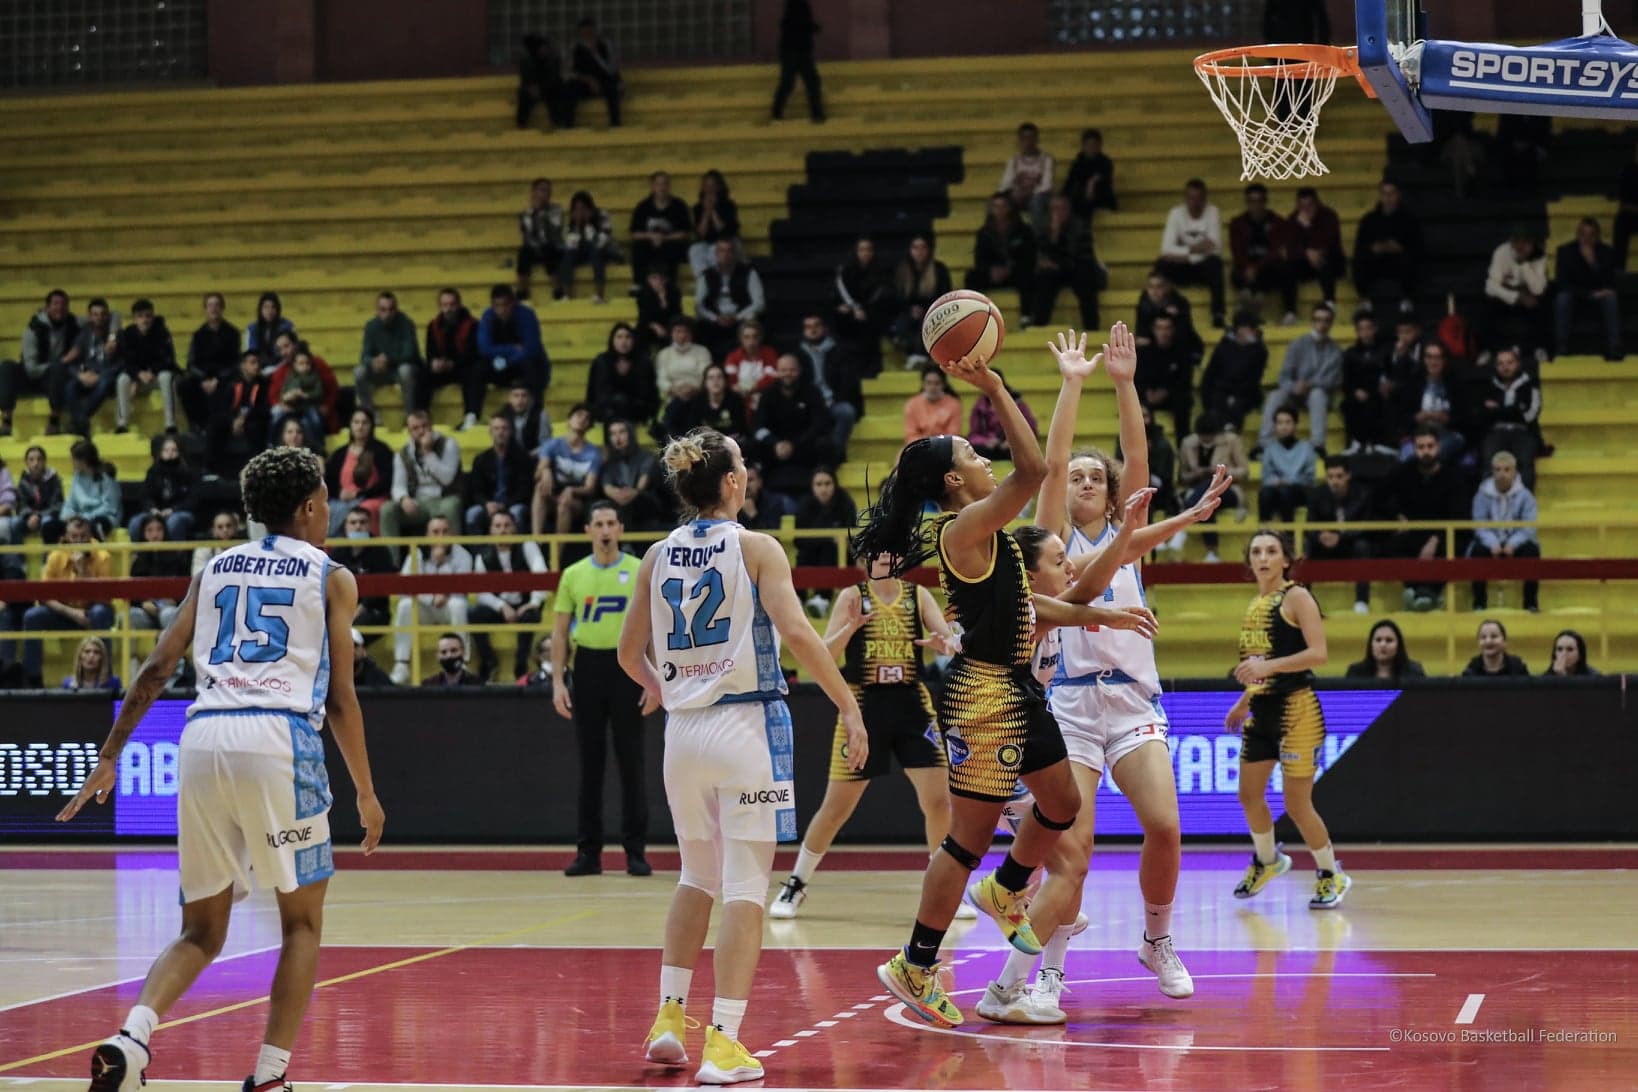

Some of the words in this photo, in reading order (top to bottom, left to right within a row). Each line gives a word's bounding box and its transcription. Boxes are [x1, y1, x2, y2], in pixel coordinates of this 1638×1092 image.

[212, 554, 310, 577] ROBERTSON
[661, 566, 731, 651] 12
[209, 585, 296, 665] 15
[880, 618, 899, 636] 13
[864, 639, 916, 659] PENZA
